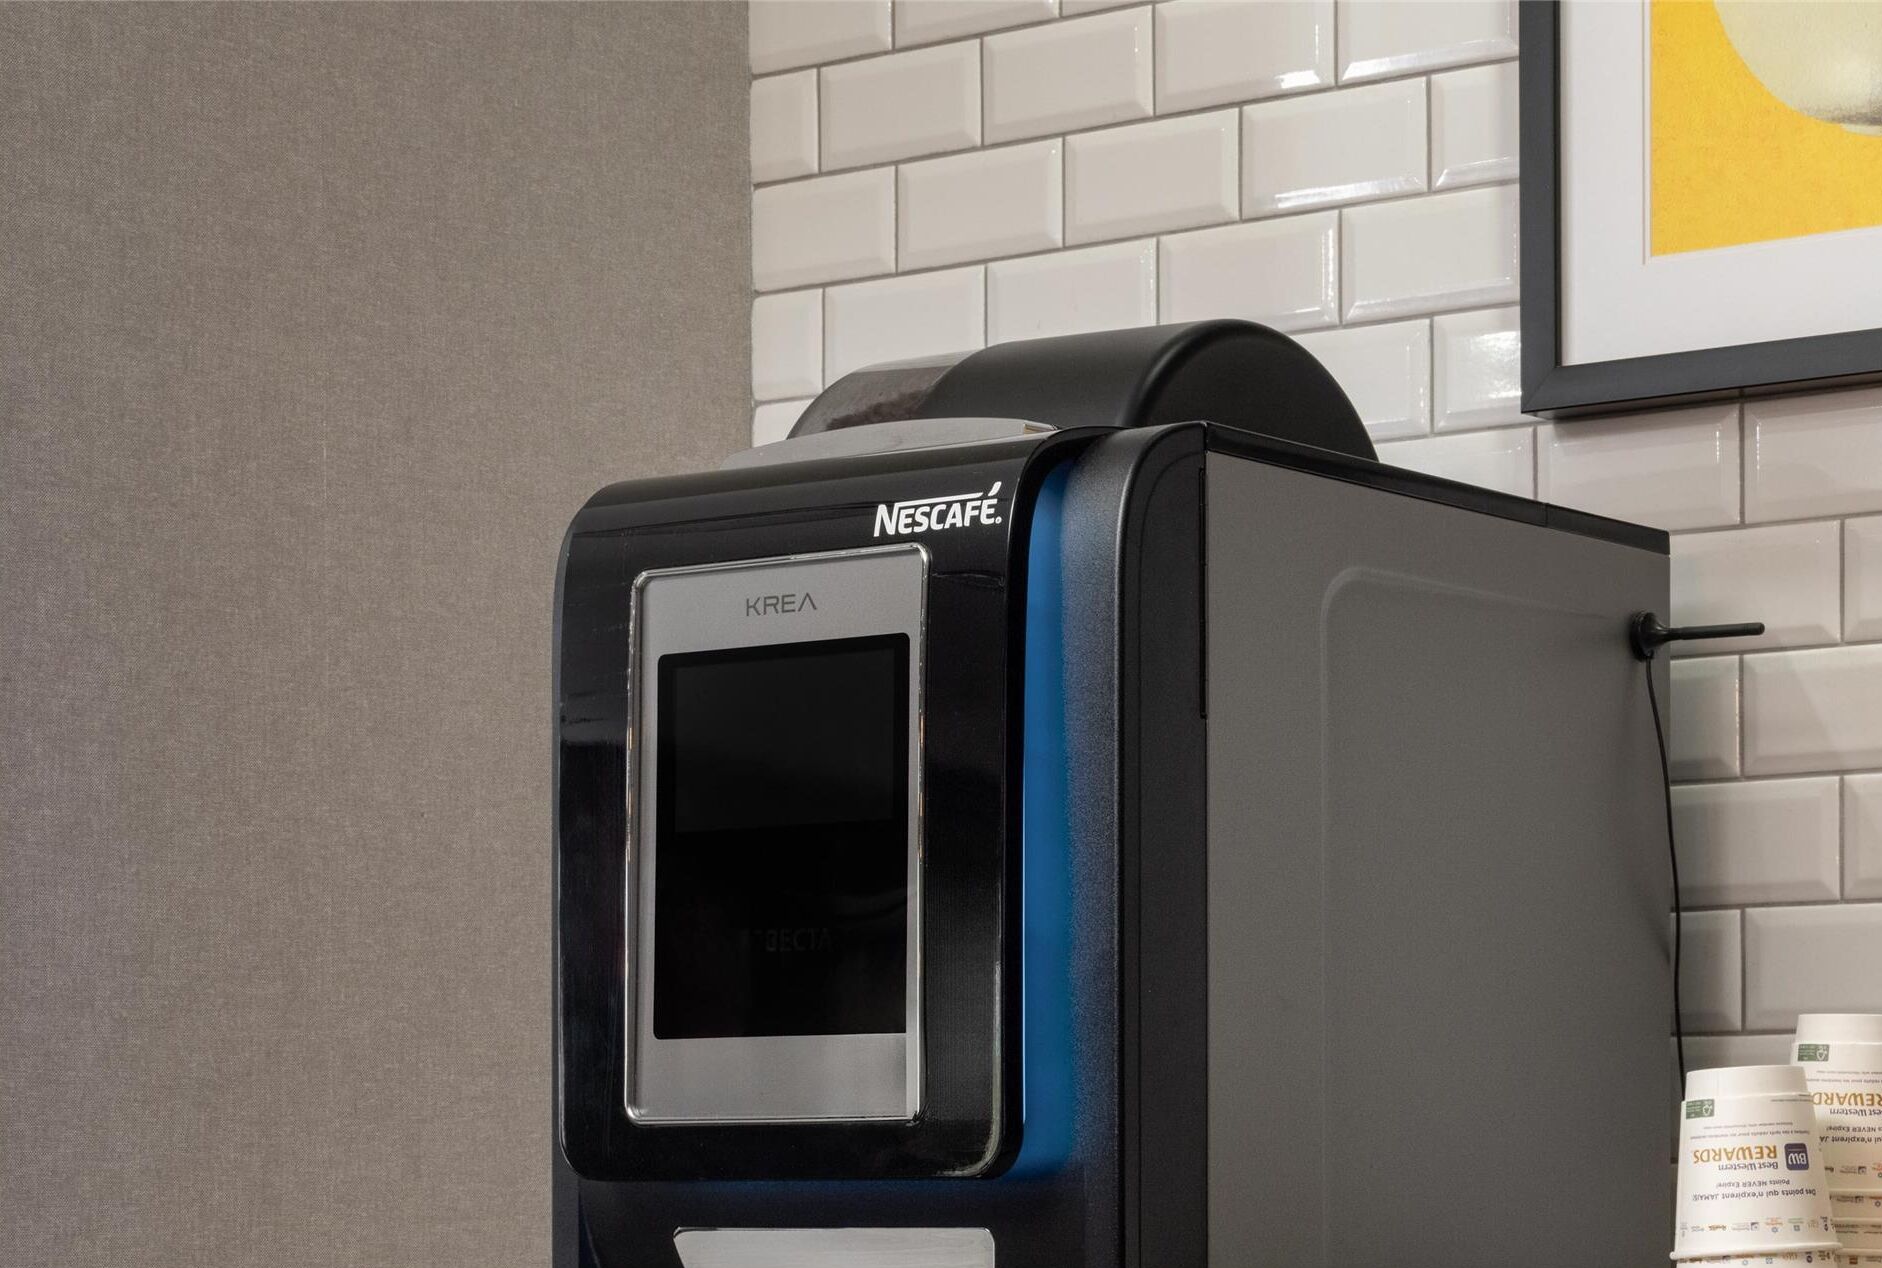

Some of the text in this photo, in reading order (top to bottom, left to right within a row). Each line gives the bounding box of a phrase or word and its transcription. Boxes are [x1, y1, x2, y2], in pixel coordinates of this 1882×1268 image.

[873, 481, 1002, 537] NESCAFÉ
[746, 592, 817, 616] KREA
[1829, 1108, 1868, 1117] Western
[1693, 1145, 1778, 1164] REWARDS
[1788, 1152, 1807, 1165] BW
[1718, 1162, 1779, 1171] Best Western
[1742, 1180, 1767, 1188] NEVER
[1722, 1190, 1764, 1200] n'expirent
[1766, 1189, 1779, 1198] qui
[1781, 1188, 1804, 1197] points
[1804, 1188, 1816, 1197] Des
